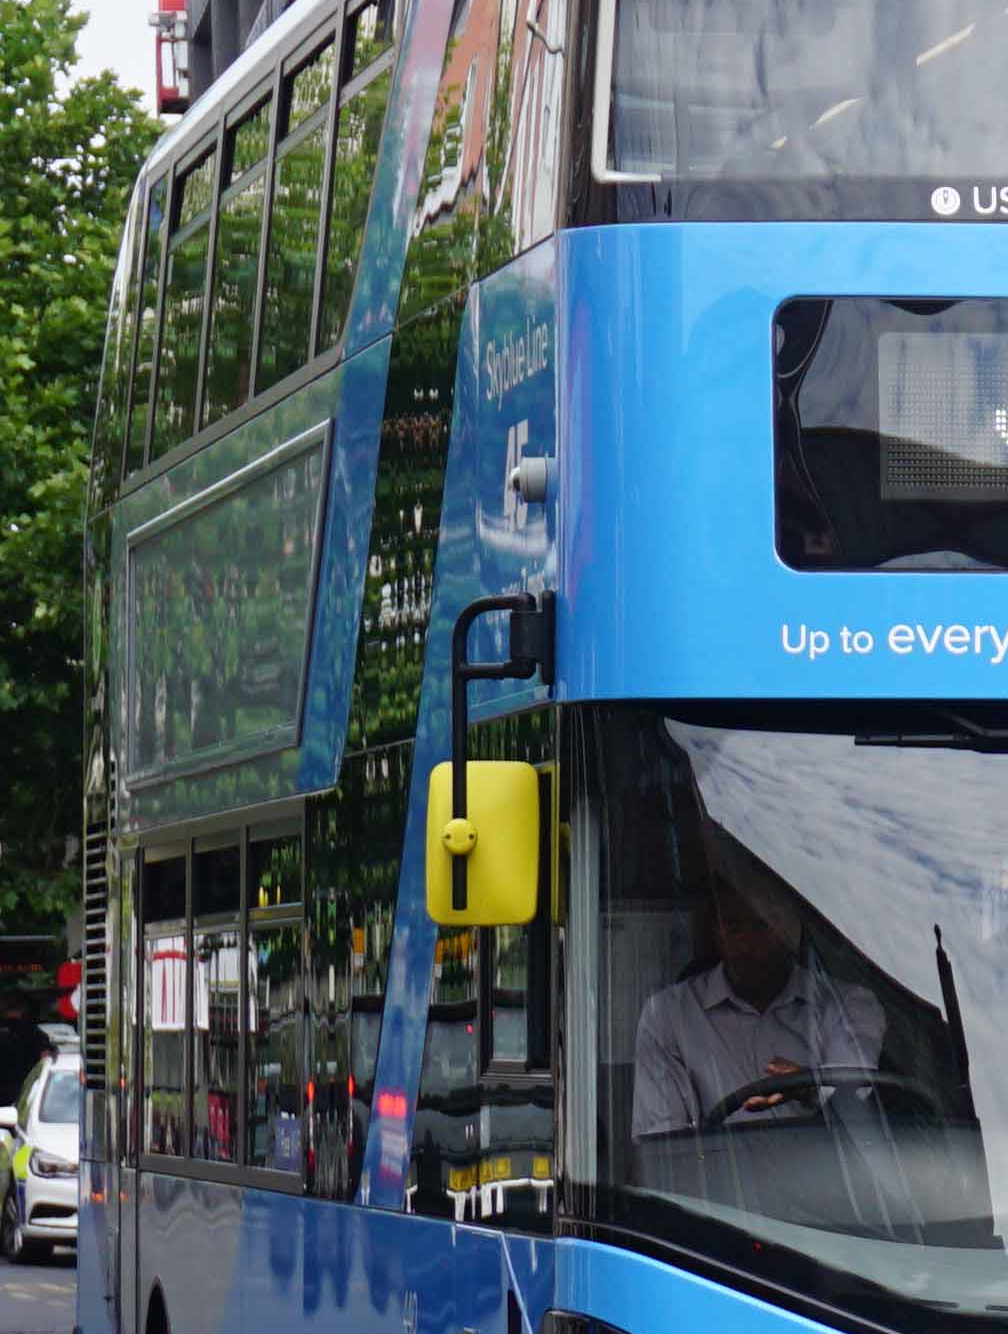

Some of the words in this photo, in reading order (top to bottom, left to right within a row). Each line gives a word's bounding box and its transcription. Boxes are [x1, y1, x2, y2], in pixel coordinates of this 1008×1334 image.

[486, 328, 525, 411] Skyblue
[527, 314, 549, 378] Line
[781, 623, 831, 660] Up
[839, 625, 874, 654] to
